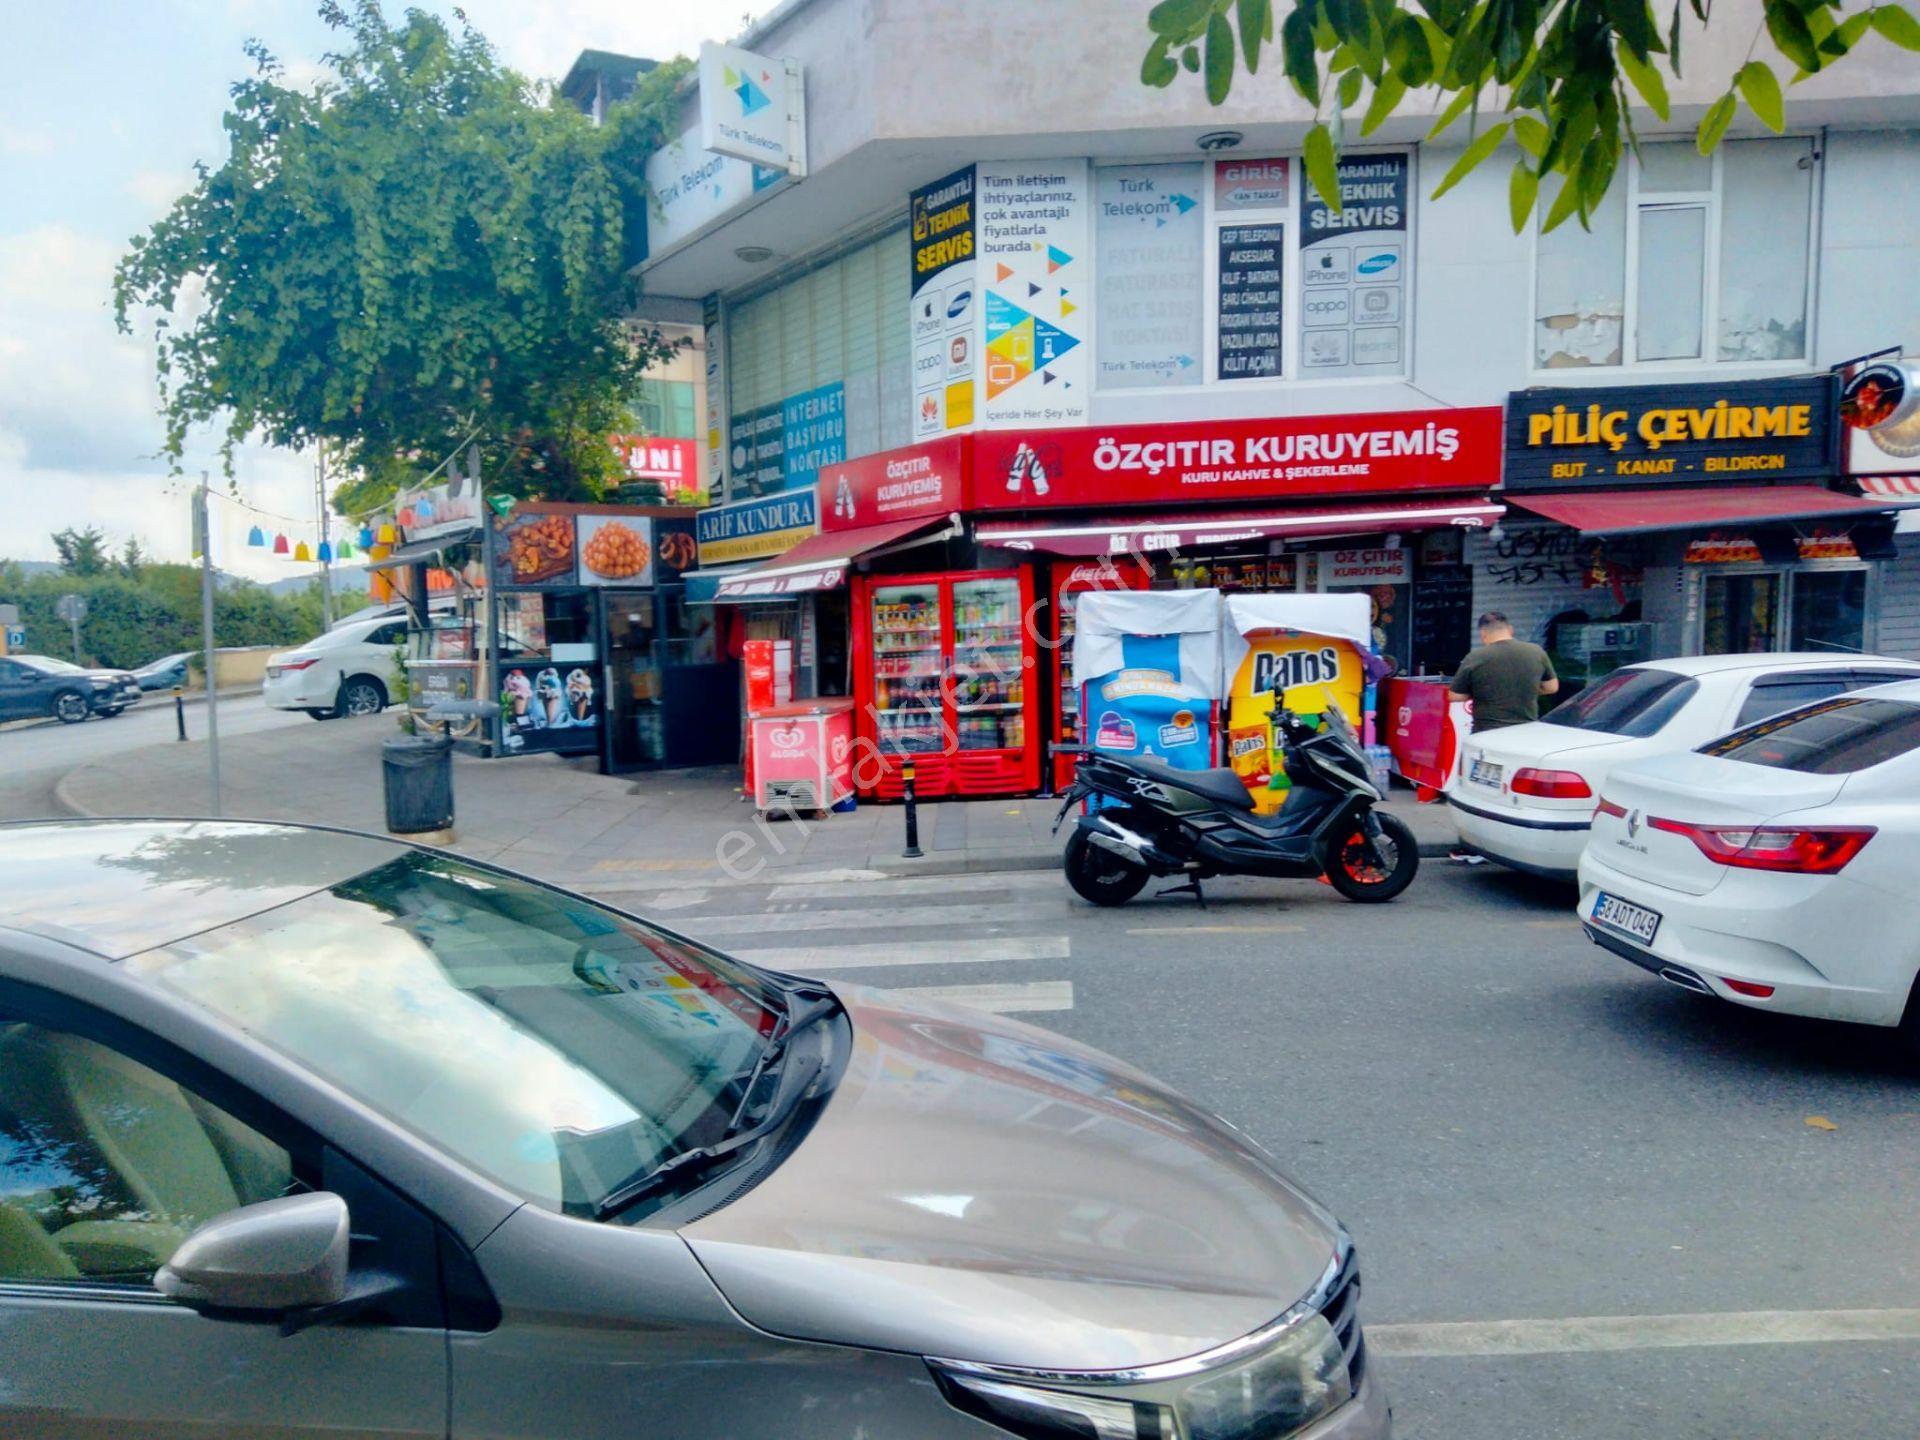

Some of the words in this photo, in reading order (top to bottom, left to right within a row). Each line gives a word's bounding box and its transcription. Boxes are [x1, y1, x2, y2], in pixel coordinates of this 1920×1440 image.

[719, 123, 741, 140] Türk
[742, 130, 783, 151] Telekom
[681, 155, 724, 195] Telekom
[1225, 165, 1283, 182] GİRİŞ
[1338, 161, 1399, 178] ARANTİLİ
[983, 175, 1012, 188] Tüm
[1016, 174, 1066, 188] iletişim
[1119, 178, 1154, 194] Türk
[983, 208, 1007, 222] çok
[1010, 206, 1070, 221] avantajlı
[1102, 200, 1170, 216] Telekom
[983, 224, 1047, 237] fiyatlarla
[983, 240, 1032, 253] burada
[1229, 249, 1275, 263] AKSESUAR
[1306, 270, 1346, 281] iPhone
[1306, 301, 1346, 313] oppo
[1255, 333, 1279, 347] ATMA
[1102, 360, 1129, 372] Türk
[1130, 359, 1177, 371] Telekom
[1223, 352, 1247, 371] KİLİT
[1248, 355, 1276, 375] AÇMA
[986, 409, 1021, 421] İçeride
[1023, 410, 1041, 419] Her
[1044, 408, 1063, 420] Şey
[1066, 407, 1084, 417] Var
[787, 417, 843, 450] BAŞVURU
[1527, 403, 1629, 451] PİLİÇ
[1638, 400, 1811, 450] ÇEVİRME
[1093, 437, 1234, 475] ÖZÇITIR
[1245, 422, 1460, 463] KURUYEMİŞ
[886, 455, 931, 479] ÖZÇITIR
[1181, 470, 1221, 484] KURU
[1222, 467, 1271, 482] KAHVE
[1273, 467, 1283, 479] &
[1285, 463, 1369, 481] ŞEKERLEME
[1552, 462, 1586, 479] BUT
[1616, 458, 1676, 476] KANAT
[1705, 454, 1785, 473] BILDIRCIN
[876, 473, 943, 502] KURUYEMİŞ
[701, 510, 733, 541] ARİF
[736, 498, 813, 534] KUNDURA
[1110, 532, 1127, 553] ÖZ
[1143, 533, 1180, 551] ÇITIR
[1361, 549, 1404, 564] ÇITIR
[1333, 563, 1404, 577] KURUYEMİŞ
[1612, 902, 1635, 928] ADT
[1632, 912, 1656, 936] 049
